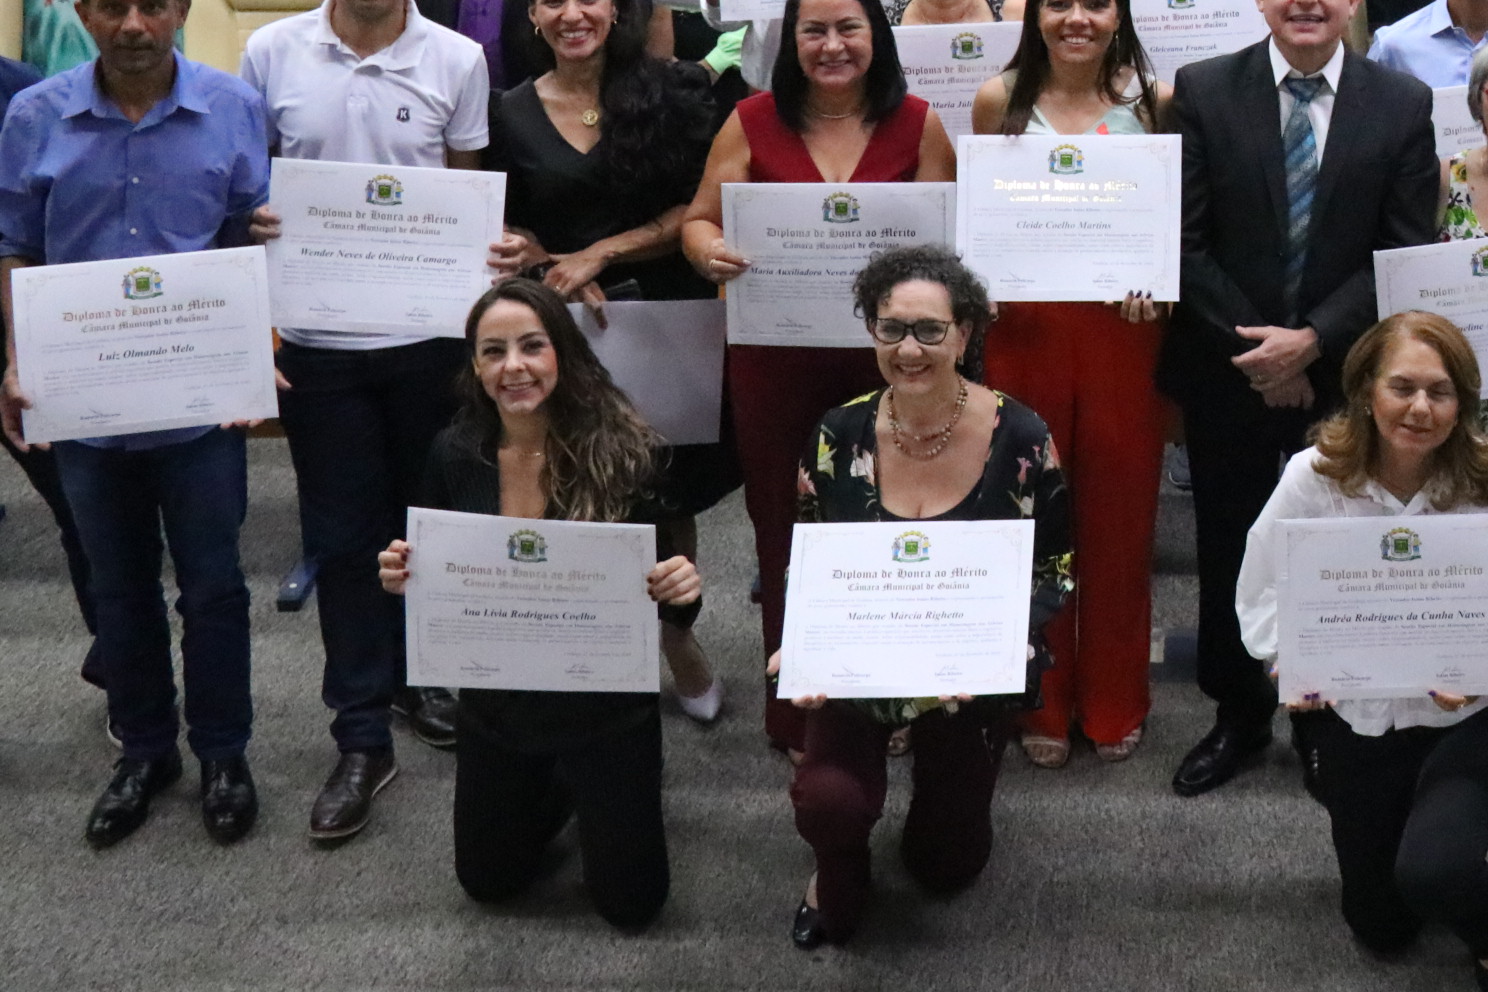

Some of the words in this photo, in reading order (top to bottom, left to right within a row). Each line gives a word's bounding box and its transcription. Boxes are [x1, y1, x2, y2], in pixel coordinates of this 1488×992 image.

[308, 207, 351, 220] Diploma
[355, 210, 366, 219] de
[371, 210, 404, 222] Honra
[407, 214, 418, 222] ao
[423, 213, 458, 225] Mérito
[766, 227, 810, 239] Diploma
[814, 228, 825, 238] de
[829, 227, 861, 239] Honra
[865, 229, 877, 238] ao
[880, 226, 916, 238] Mérito
[1016, 221, 1043, 230] Cleide
[1046, 221, 1075, 230] Coelho
[1079, 221, 1111, 230] Martins
[301, 247, 334, 258] Wender
[338, 249, 362, 259] Neves
[365, 251, 375, 260] de
[378, 252, 414, 262] Oliveira
[417, 253, 457, 265] Camargo
[750, 266, 773, 275] Maria
[776, 268, 822, 277] Auxiliadora
[825, 268, 847, 276] Neves
[62, 309, 111, 322] Diploma
[115, 309, 126, 318] de
[131, 305, 167, 316] Honra
[172, 304, 183, 312] ao
[187, 298, 226, 311] Mérito
[98, 351, 120, 362] Luiz
[123, 346, 167, 359] Olmando
[170, 344, 195, 354] Melo
[832, 568, 878, 580] Diploma
[882, 569, 892, 578] de
[897, 568, 931, 579] Honra
[935, 569, 946, 578] ao
[950, 565, 988, 578] Mérito
[1320, 568, 1368, 581] Diploma
[1372, 569, 1383, 579] de
[1388, 566, 1423, 578] Honra
[1428, 567, 1440, 577] ao
[1444, 563, 1483, 577] Mérito
[461, 607, 480, 617] Ana
[510, 609, 559, 621] Rodrigues
[562, 610, 596, 621] Coelho
[847, 611, 886, 621] Marlene
[889, 610, 922, 620] Márcia
[925, 610, 964, 622] Righetto
[1317, 614, 1352, 624] Andréa
[1355, 612, 1403, 623] Rodrigues
[1406, 611, 1417, 621] da
[1422, 610, 1453, 621] Cunha
[1456, 610, 1485, 619] Naves
